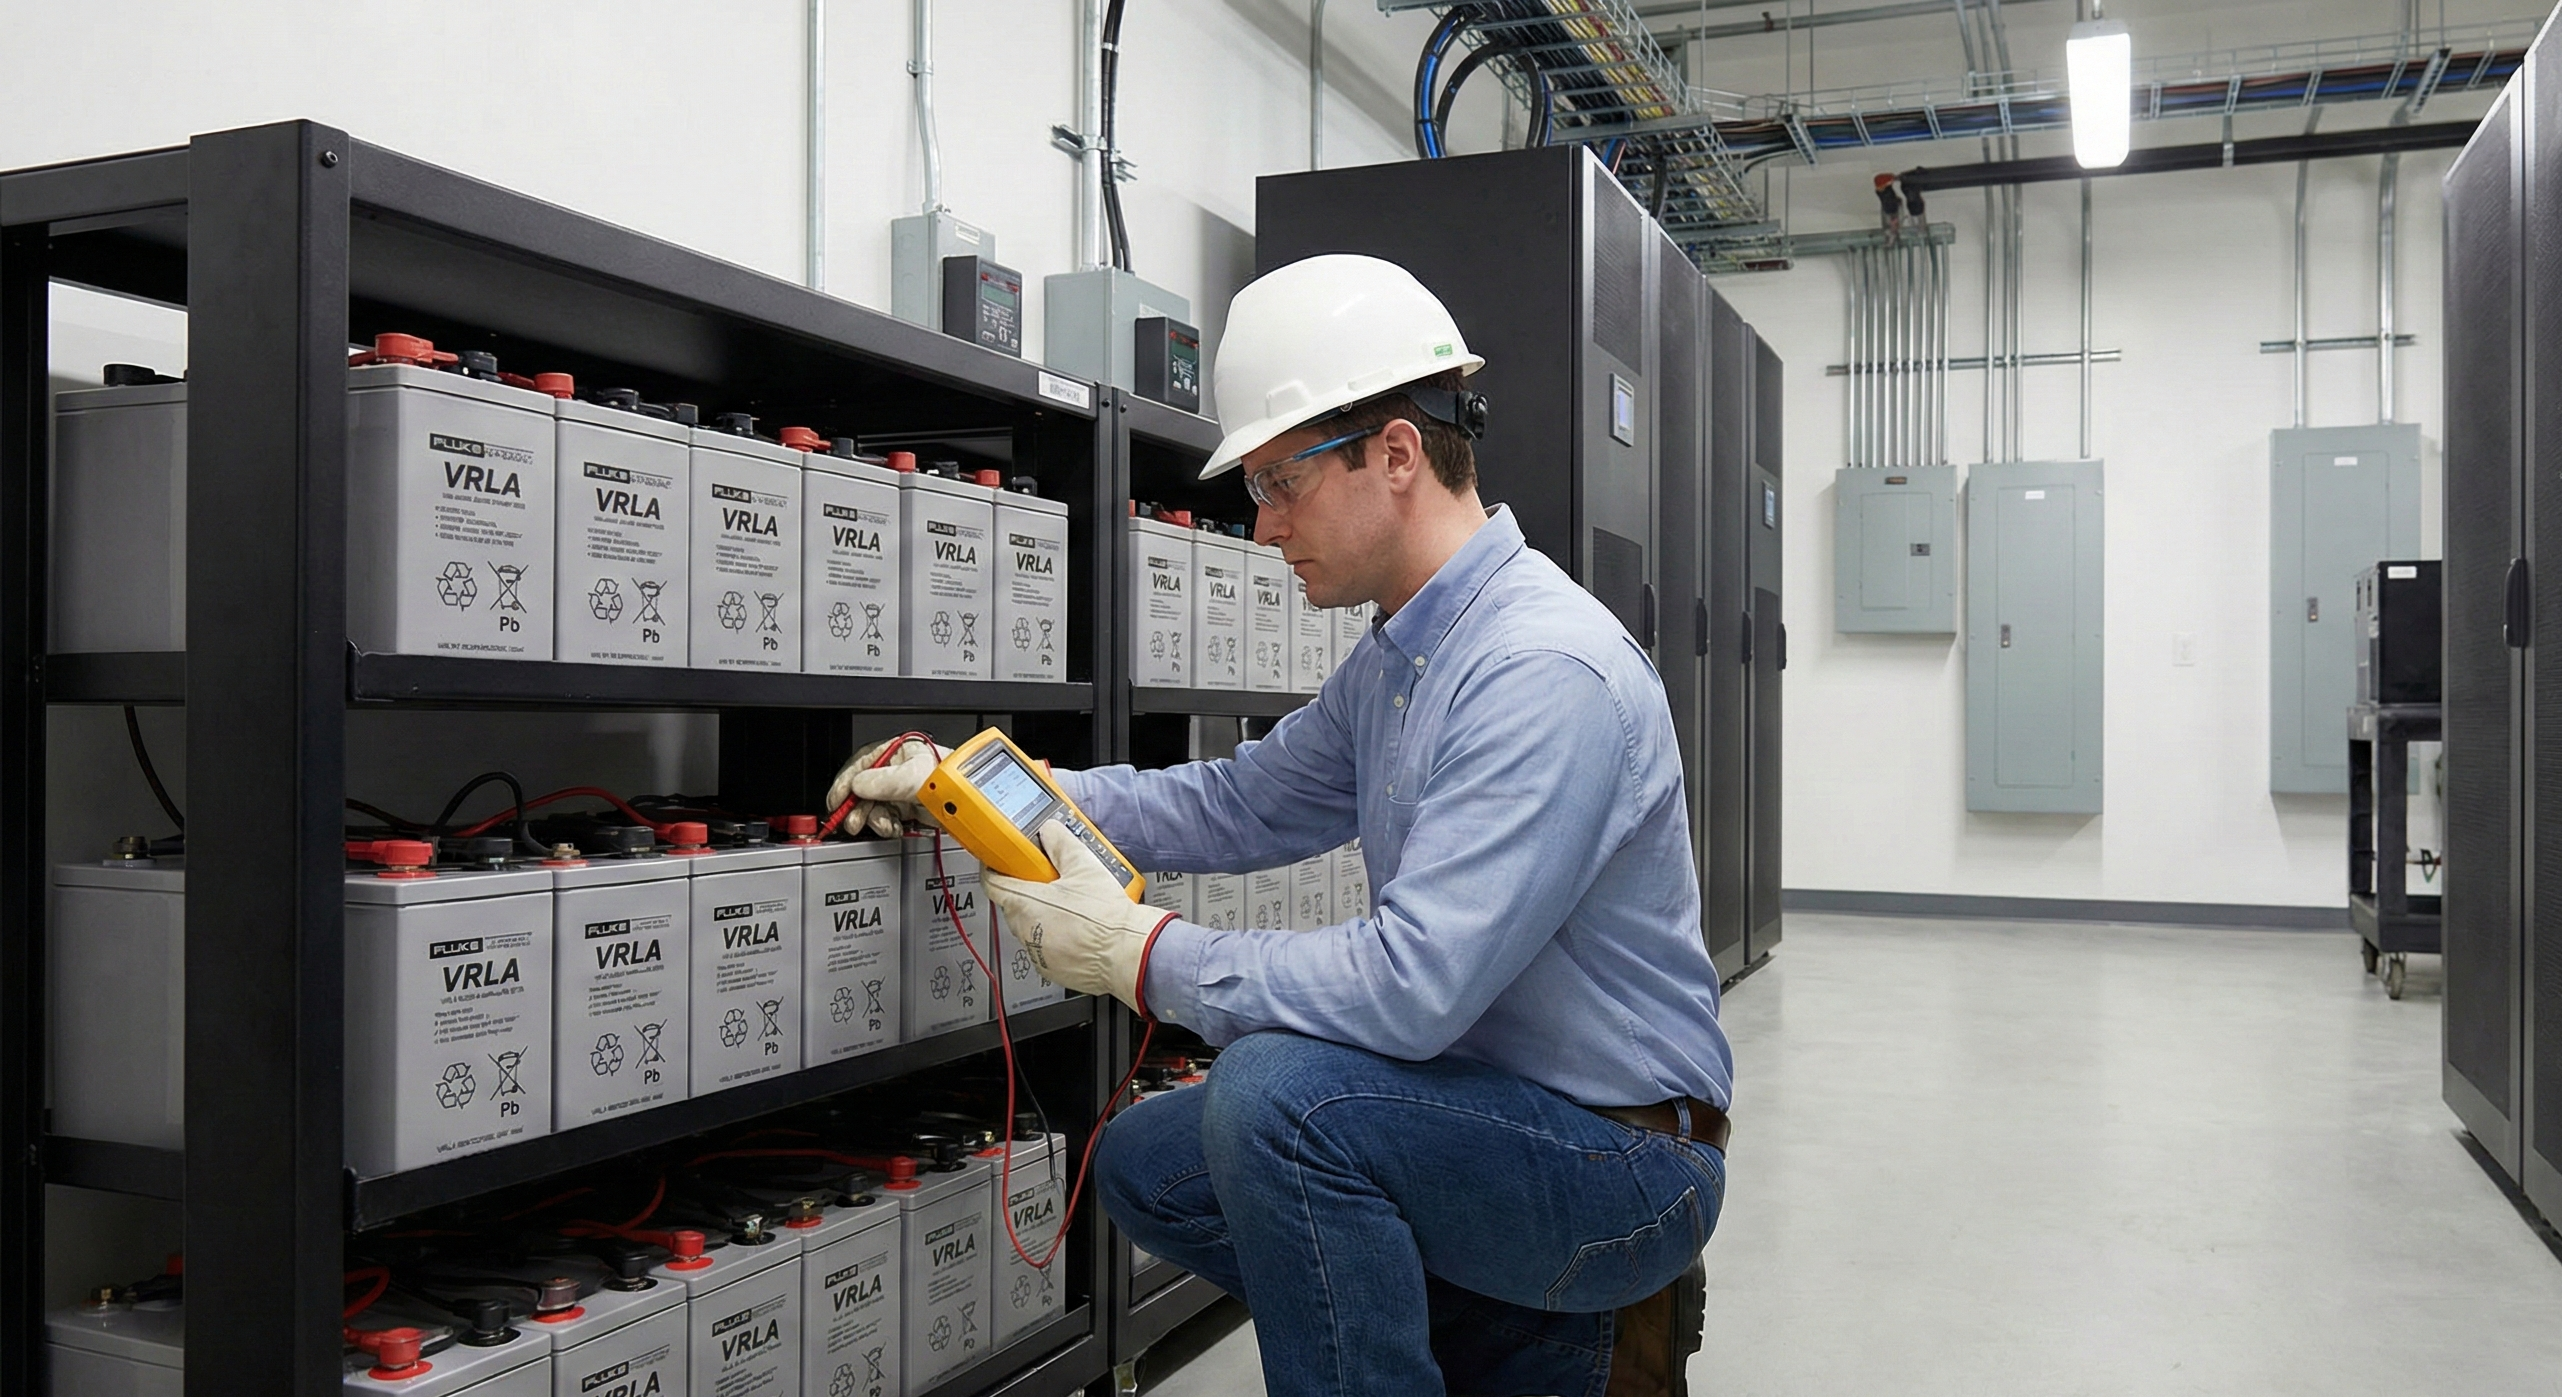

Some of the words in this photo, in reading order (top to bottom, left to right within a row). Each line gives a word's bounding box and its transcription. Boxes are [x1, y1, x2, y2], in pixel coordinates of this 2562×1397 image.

[443, 461, 521, 498] VRLA
[596, 487, 660, 520] VRLA
[722, 507, 778, 537] VRLA
[833, 525, 881, 552] VRLA
[935, 540, 976, 565] VRLA
[1016, 552, 1053, 575] VRLA
[1152, 572, 1181, 592] VRLA
[1209, 581, 1236, 600] VRLA
[499, 616, 521, 633] Pb
[642, 628, 660, 644] Pb
[833, 906, 882, 933] VRLA
[723, 921, 779, 950] VRLA
[596, 939, 661, 970] VRLA
[443, 957, 520, 993] VRLA
[764, 1041, 779, 1056] Pb
[644, 1068, 661, 1085] Pb
[500, 1101, 520, 1118] Pb
[1014, 1198, 1054, 1229] VRLA
[933, 1233, 976, 1267] VRLA
[834, 1274, 882, 1313] VRLA
[722, 1319, 779, 1362] VRLA
